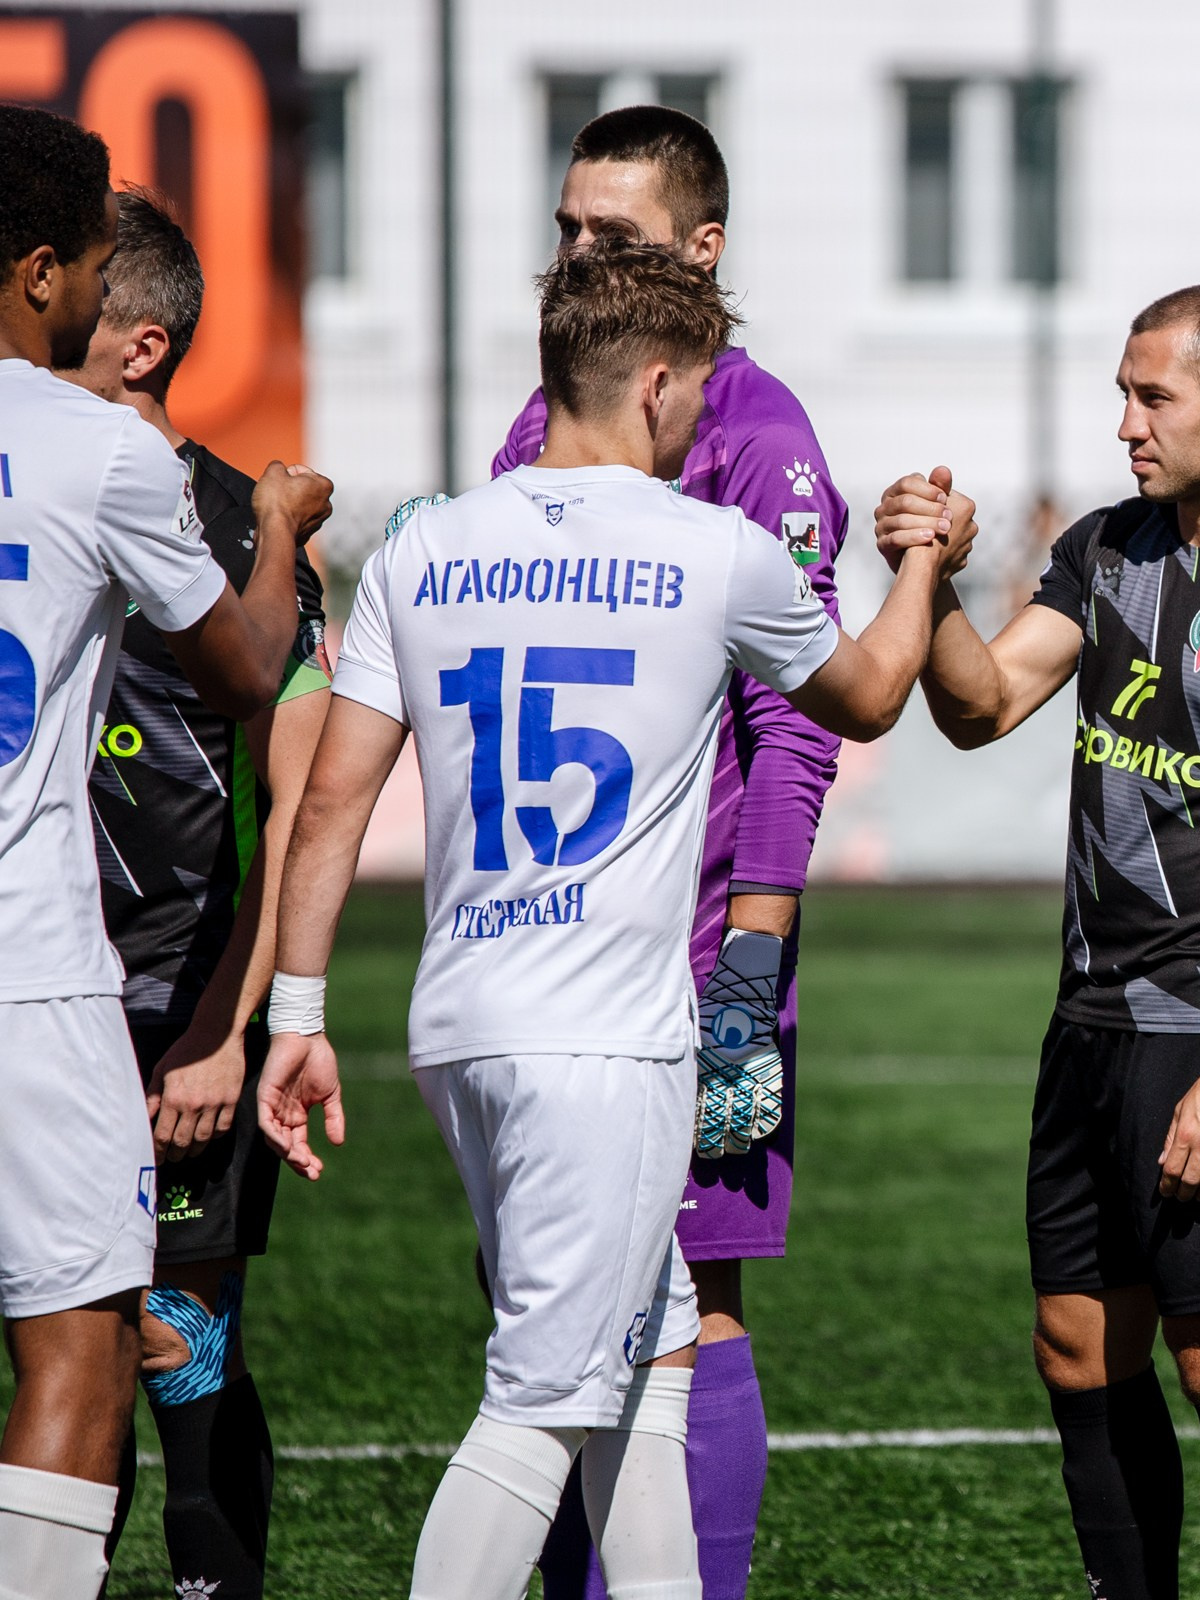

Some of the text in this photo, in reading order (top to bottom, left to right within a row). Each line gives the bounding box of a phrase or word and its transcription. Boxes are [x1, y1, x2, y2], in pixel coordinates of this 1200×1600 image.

[413, 558, 685, 612] АГАФОНЦЕВ
[439, 646, 636, 872] 15
[158, 1208, 204, 1222] KELME
